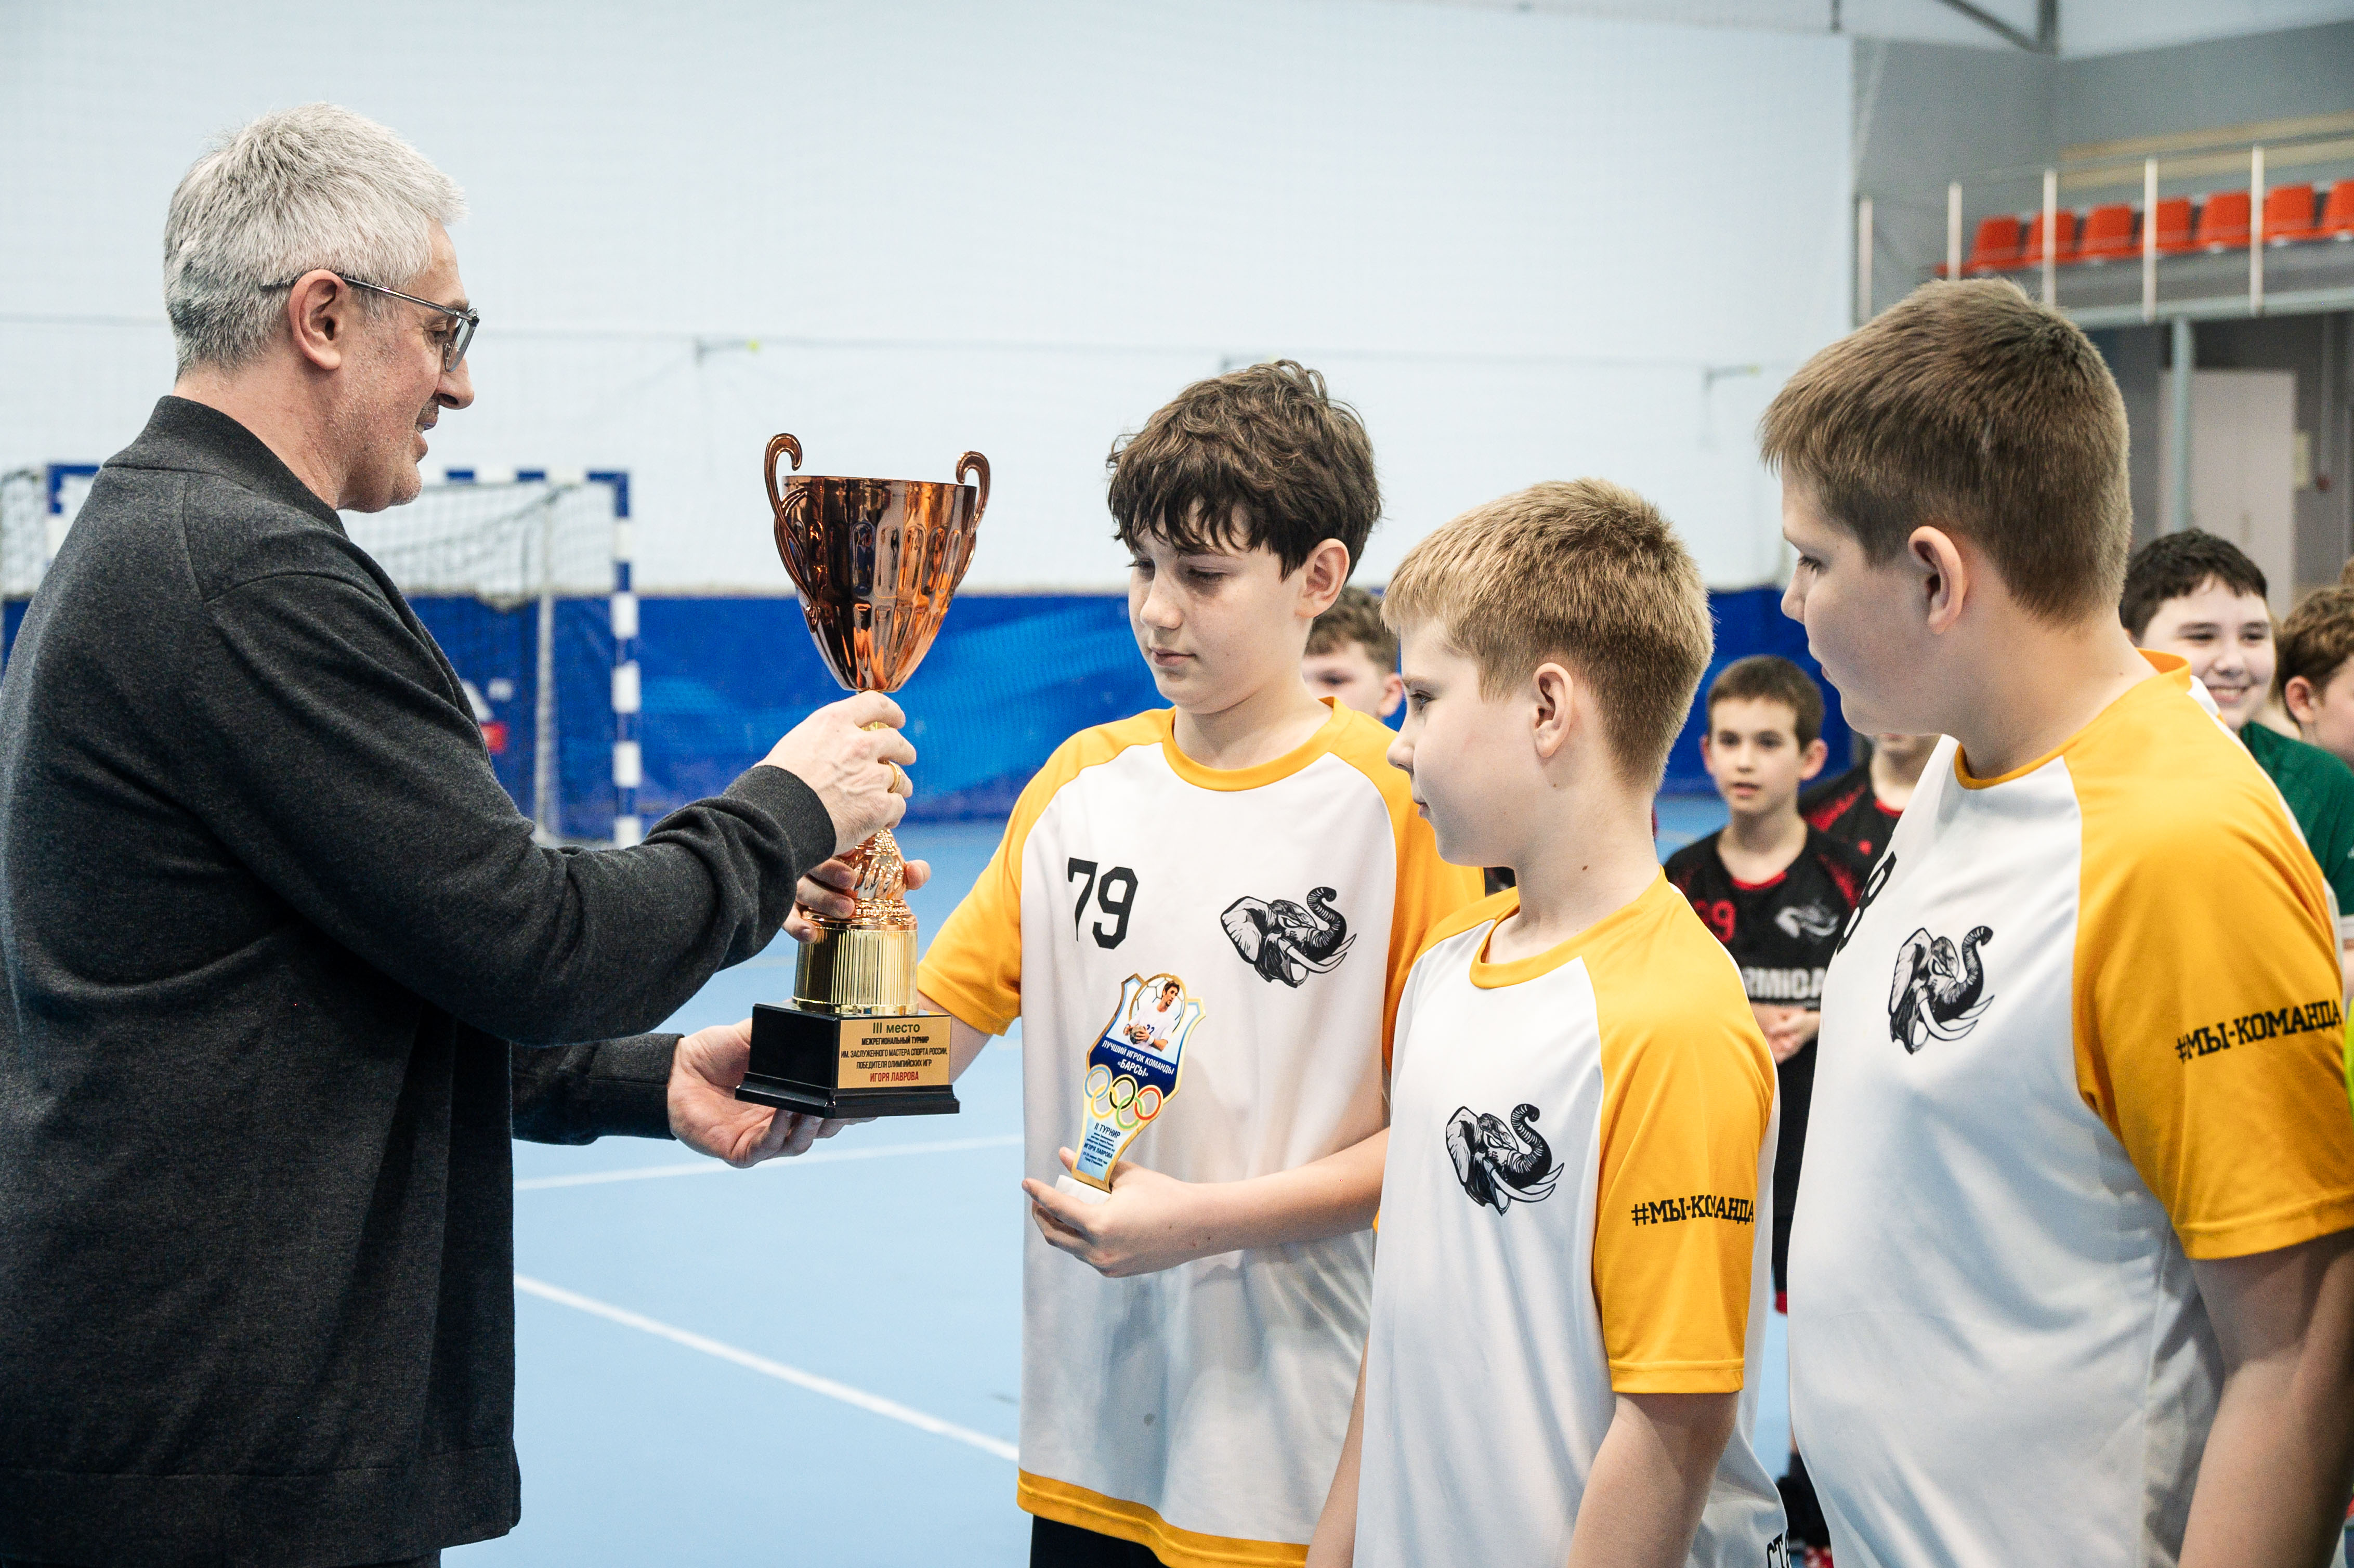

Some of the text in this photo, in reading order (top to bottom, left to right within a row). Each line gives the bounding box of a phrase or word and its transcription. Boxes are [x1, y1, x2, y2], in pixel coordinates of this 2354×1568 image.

[1068, 857, 1139, 949] 79
[872, 1022, 920, 1034] III место
[861, 1036, 911, 1045] МЕЖРЕГИОНАЛЬНЫЙ
[851, 1049, 888, 1058] ЗАСЛУЖЕННОГО
[888, 1048, 910, 1056] МАСТЕРА
[911, 1048, 928, 1056] СПОРТА
[1102, 1040, 1175, 1075] ЛУЧШИЙ ИГРОК КОМАНДЫ
[856, 1061, 887, 1069] ПОБЕДИТЕЛЯ
[887, 1059, 922, 1067] ОЛИМПИЙСКИХ
[1117, 1059, 1148, 1077] «БАРСЫ»
[870, 1071, 919, 1082] ИГОРЯ ЛАВРОВА
[1100, 1124, 1121, 1139] ТУРНИР
[1095, 1148, 1113, 1159] ЛАВРОВА
